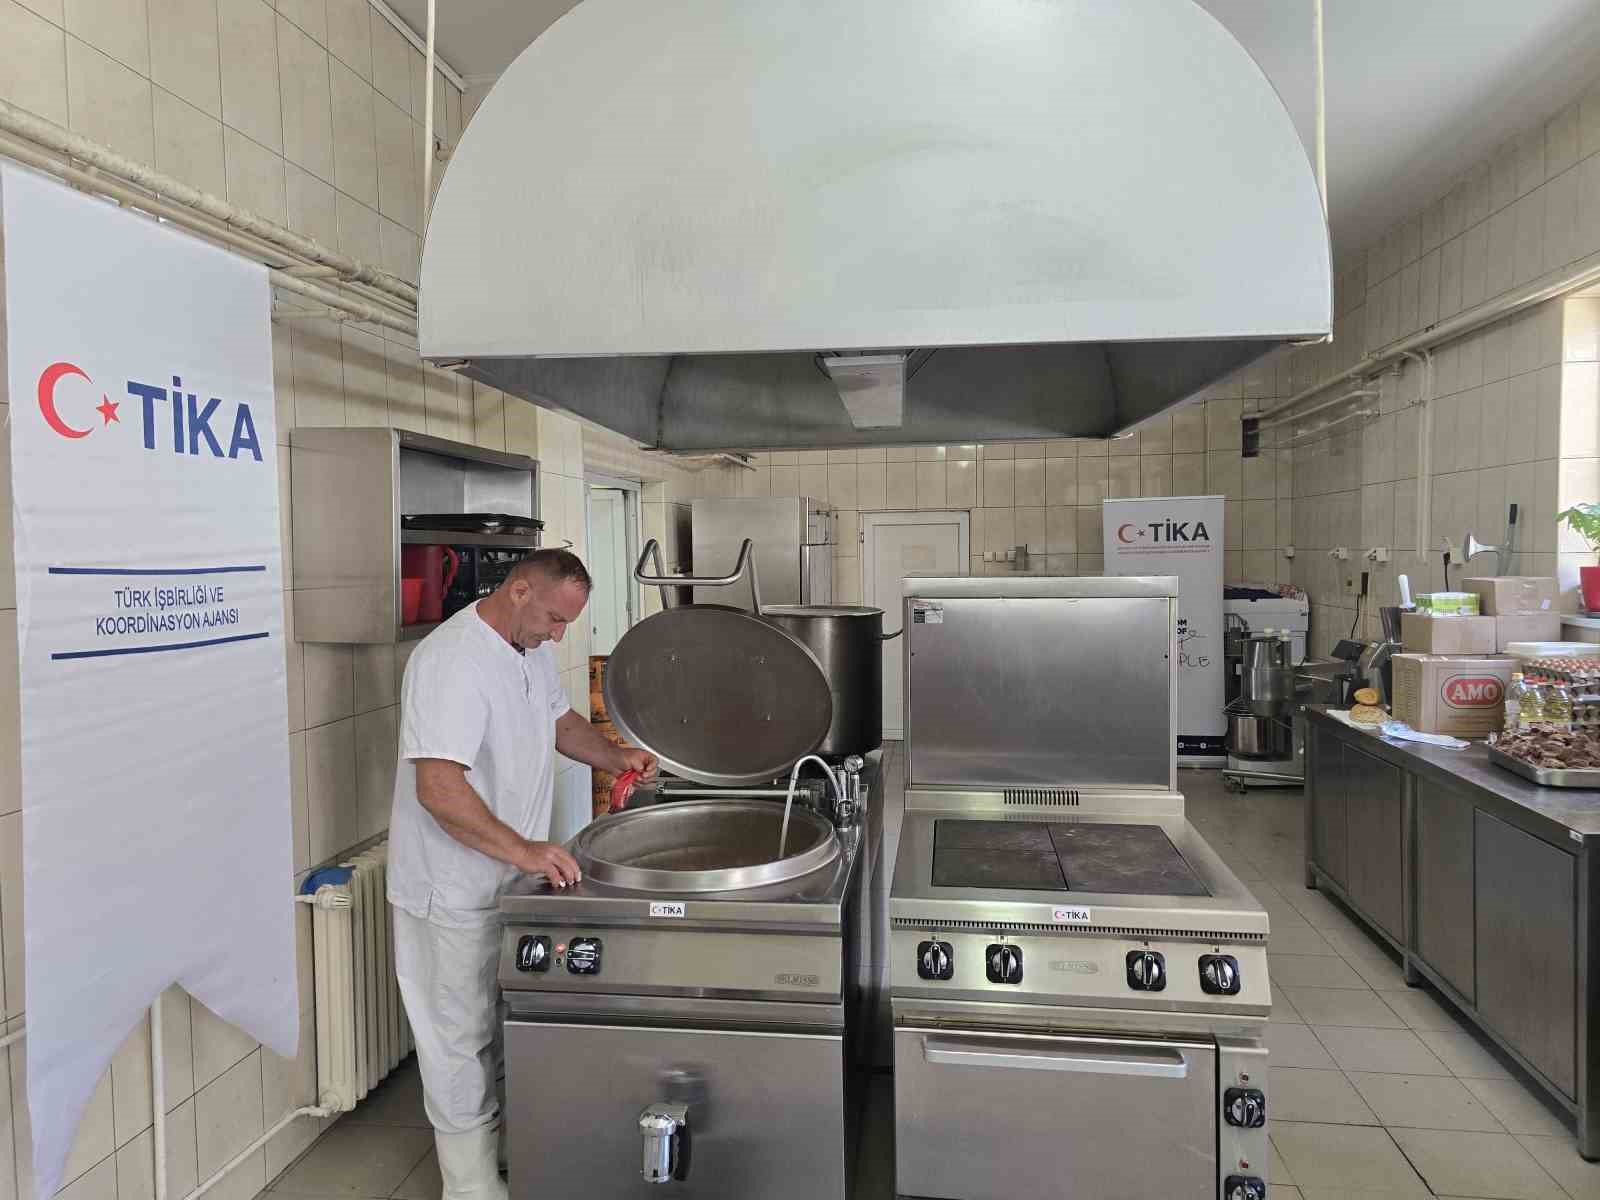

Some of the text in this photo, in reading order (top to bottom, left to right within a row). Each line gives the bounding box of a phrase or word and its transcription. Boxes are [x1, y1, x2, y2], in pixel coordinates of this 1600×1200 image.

[127, 375, 263, 461] TİKA
[1148, 518, 1210, 542] TİKA
[114, 585, 225, 610] TÜRK İŞBİRLİĞİ VE
[96, 612, 201, 635] KOORDİNASYON
[1451, 684, 1498, 700] AMO
